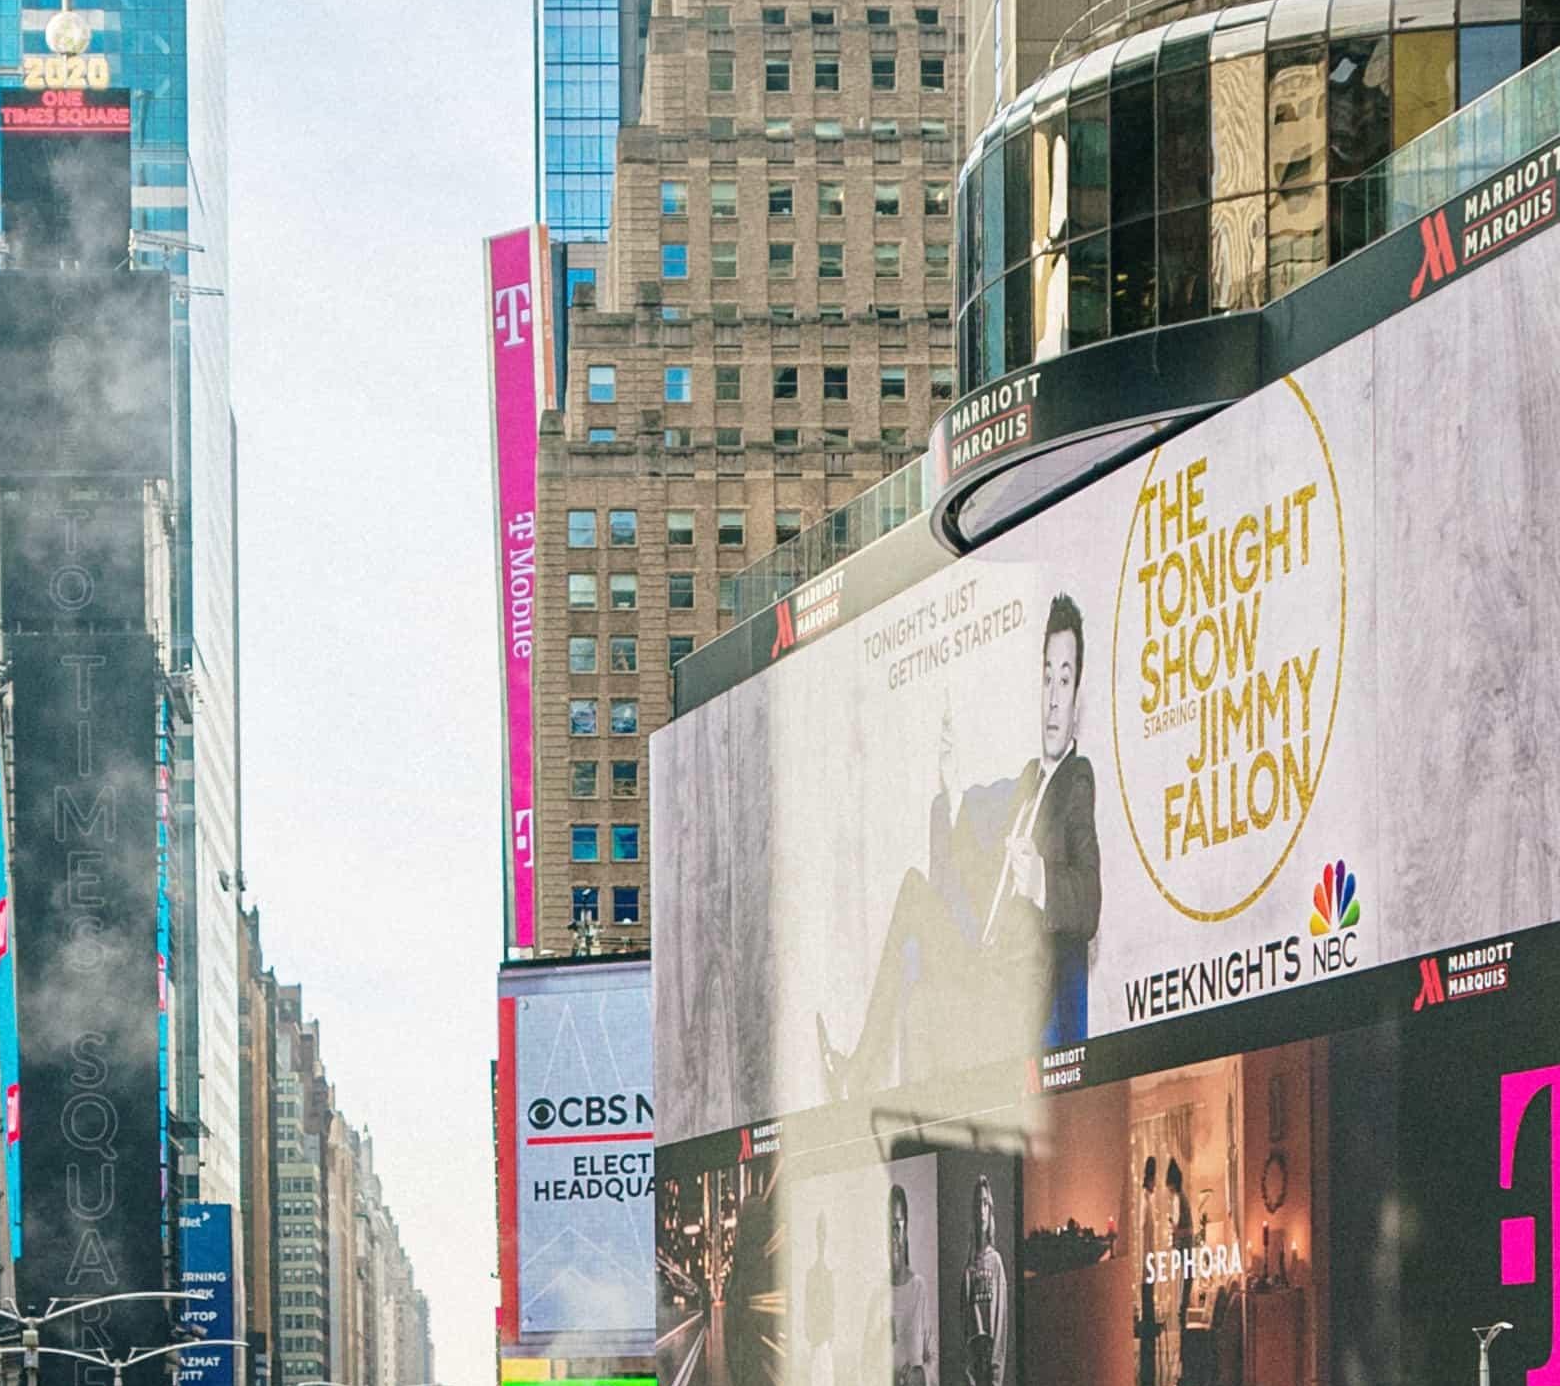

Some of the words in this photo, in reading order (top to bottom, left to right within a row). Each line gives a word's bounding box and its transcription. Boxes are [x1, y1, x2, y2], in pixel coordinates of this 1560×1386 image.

[22, 57, 109, 88] 2020
[41, 92, 85, 107] ONE
[2, 108, 54, 125] TIMES
[56, 108, 131, 125] SQUARE
[1463, 187, 1553, 259] MARQUIS
[951, 372, 1044, 437] MARRIOTT
[951, 412, 1029, 471] MARQUIS
[1139, 457, 1208, 561] THE
[1139, 483, 1317, 638] TONIGHT
[510, 549, 533, 660] Mobile
[794, 571, 845, 611] MARRIOTT
[794, 596, 840, 639] MARQUIS
[863, 603, 937, 665] TONIGHT'S
[941, 579, 978, 630] JUST
[887, 642, 949, 692] GETTING
[953, 599, 1028, 664] STARTED.
[1139, 593, 1262, 715] SHOW
[1142, 699, 1199, 740] STARRING
[1187, 648, 1321, 773] JIMMY
[1163, 737, 1314, 861] FALLON
[1126, 935, 1302, 1023] WEEKNIGHTS
[1312, 930, 1358, 976] NBC
[1447, 941, 1514, 972] MARRIOTT
[1447, 966, 1508, 996] MARQUIS
[1042, 1045, 1087, 1072] MARRIOTT
[1042, 1065, 1082, 1091] MARQUIS
[559, 1093, 628, 1127] CBS
[1145, 1242, 1244, 1284] SEPHORA
